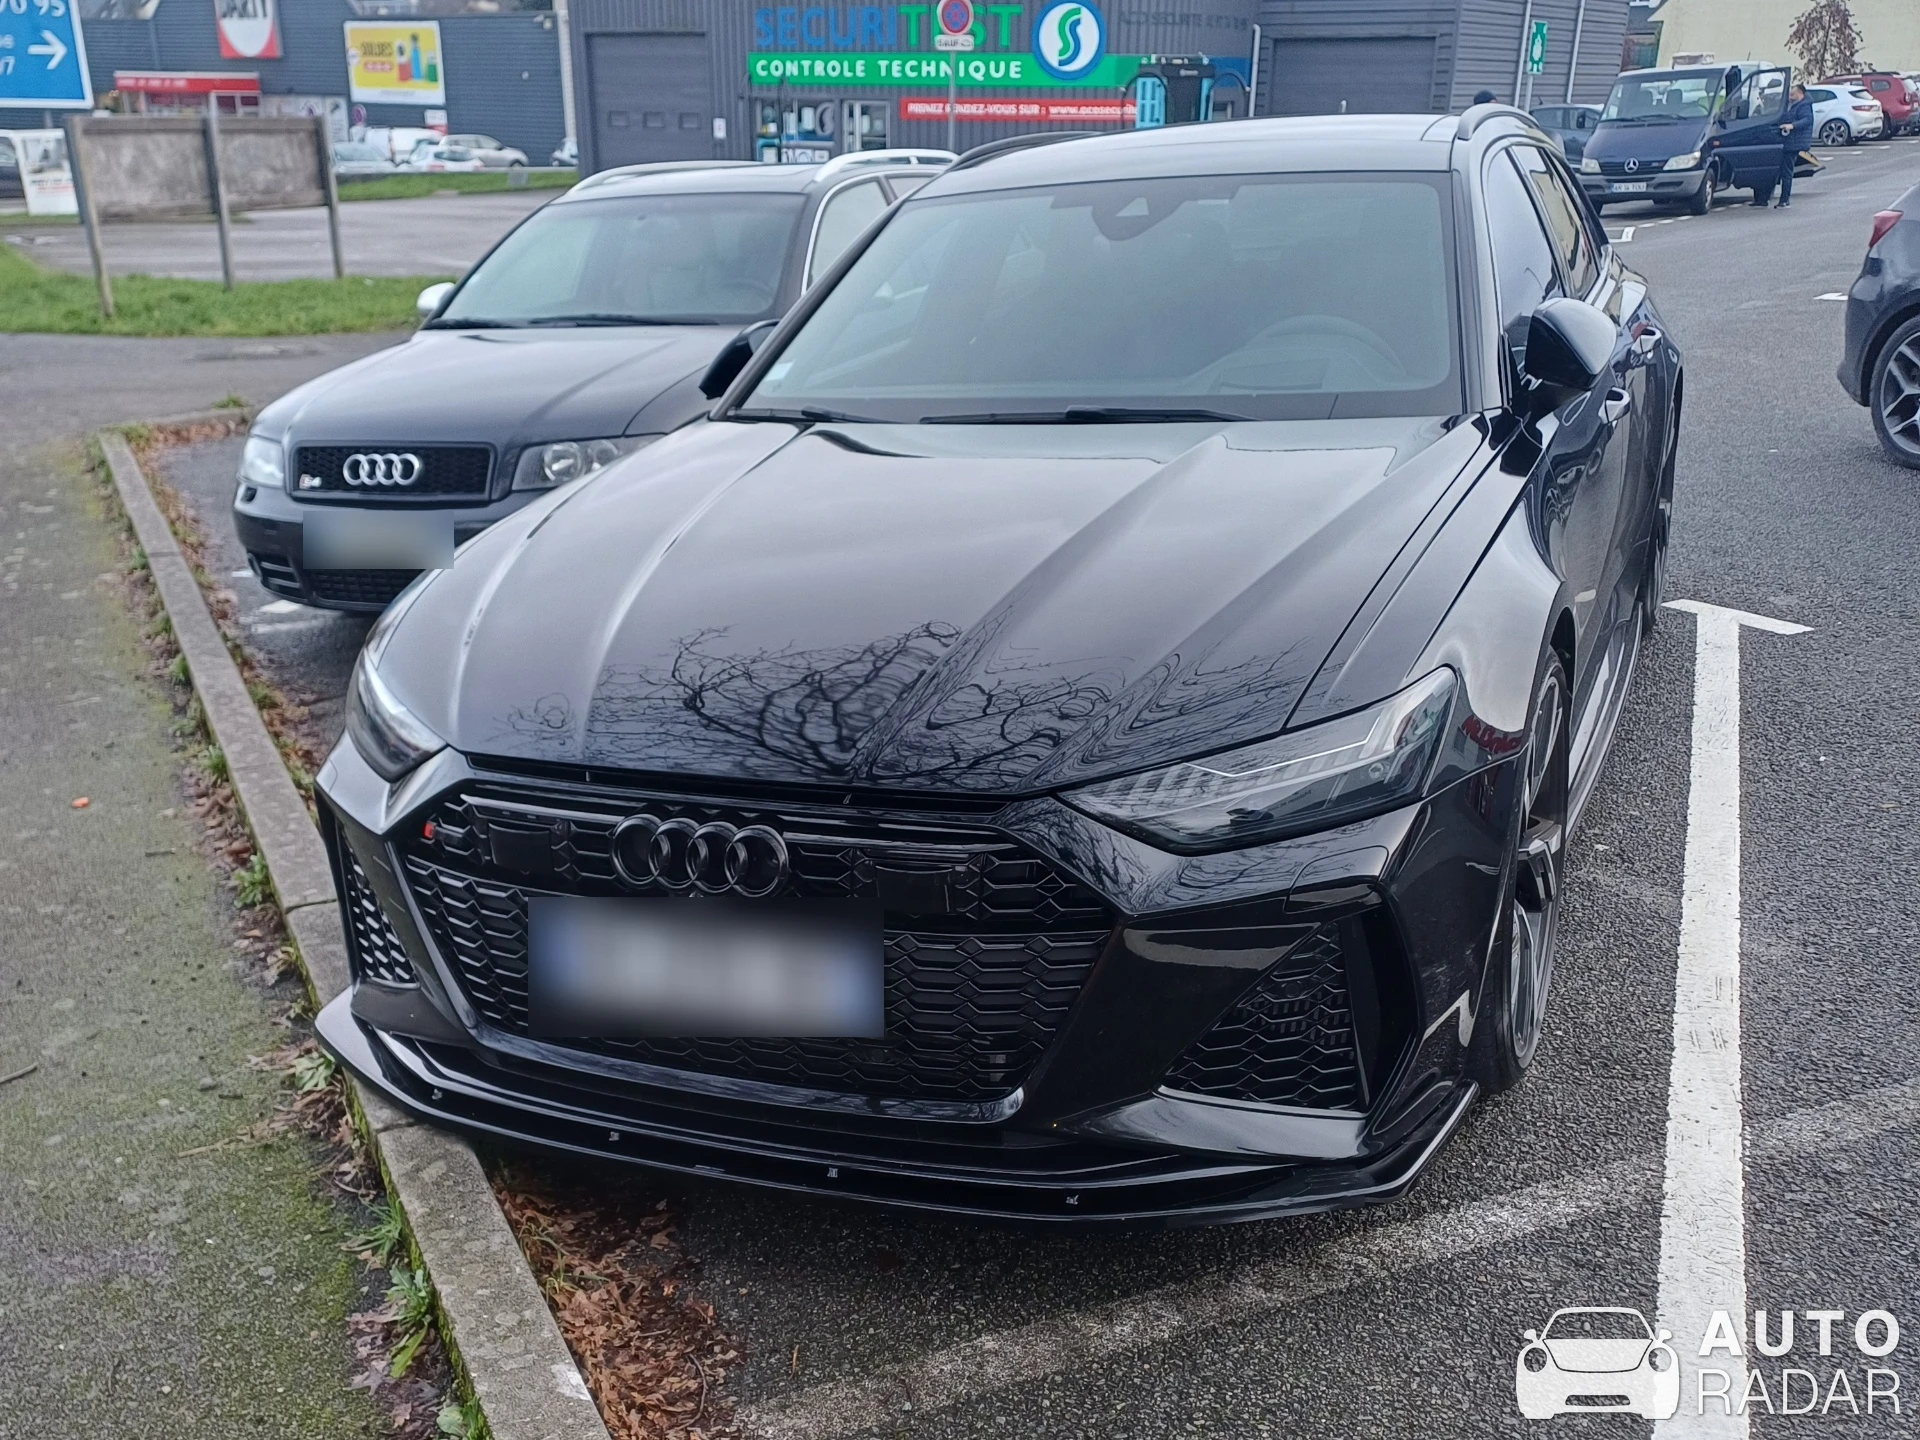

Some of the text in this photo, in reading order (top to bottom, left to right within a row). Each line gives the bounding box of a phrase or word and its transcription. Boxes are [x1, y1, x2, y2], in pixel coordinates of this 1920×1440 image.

[756, 4, 1023, 48] SECURITST
[756, 59, 1022, 81] CONTROLE TECHNIQUE
